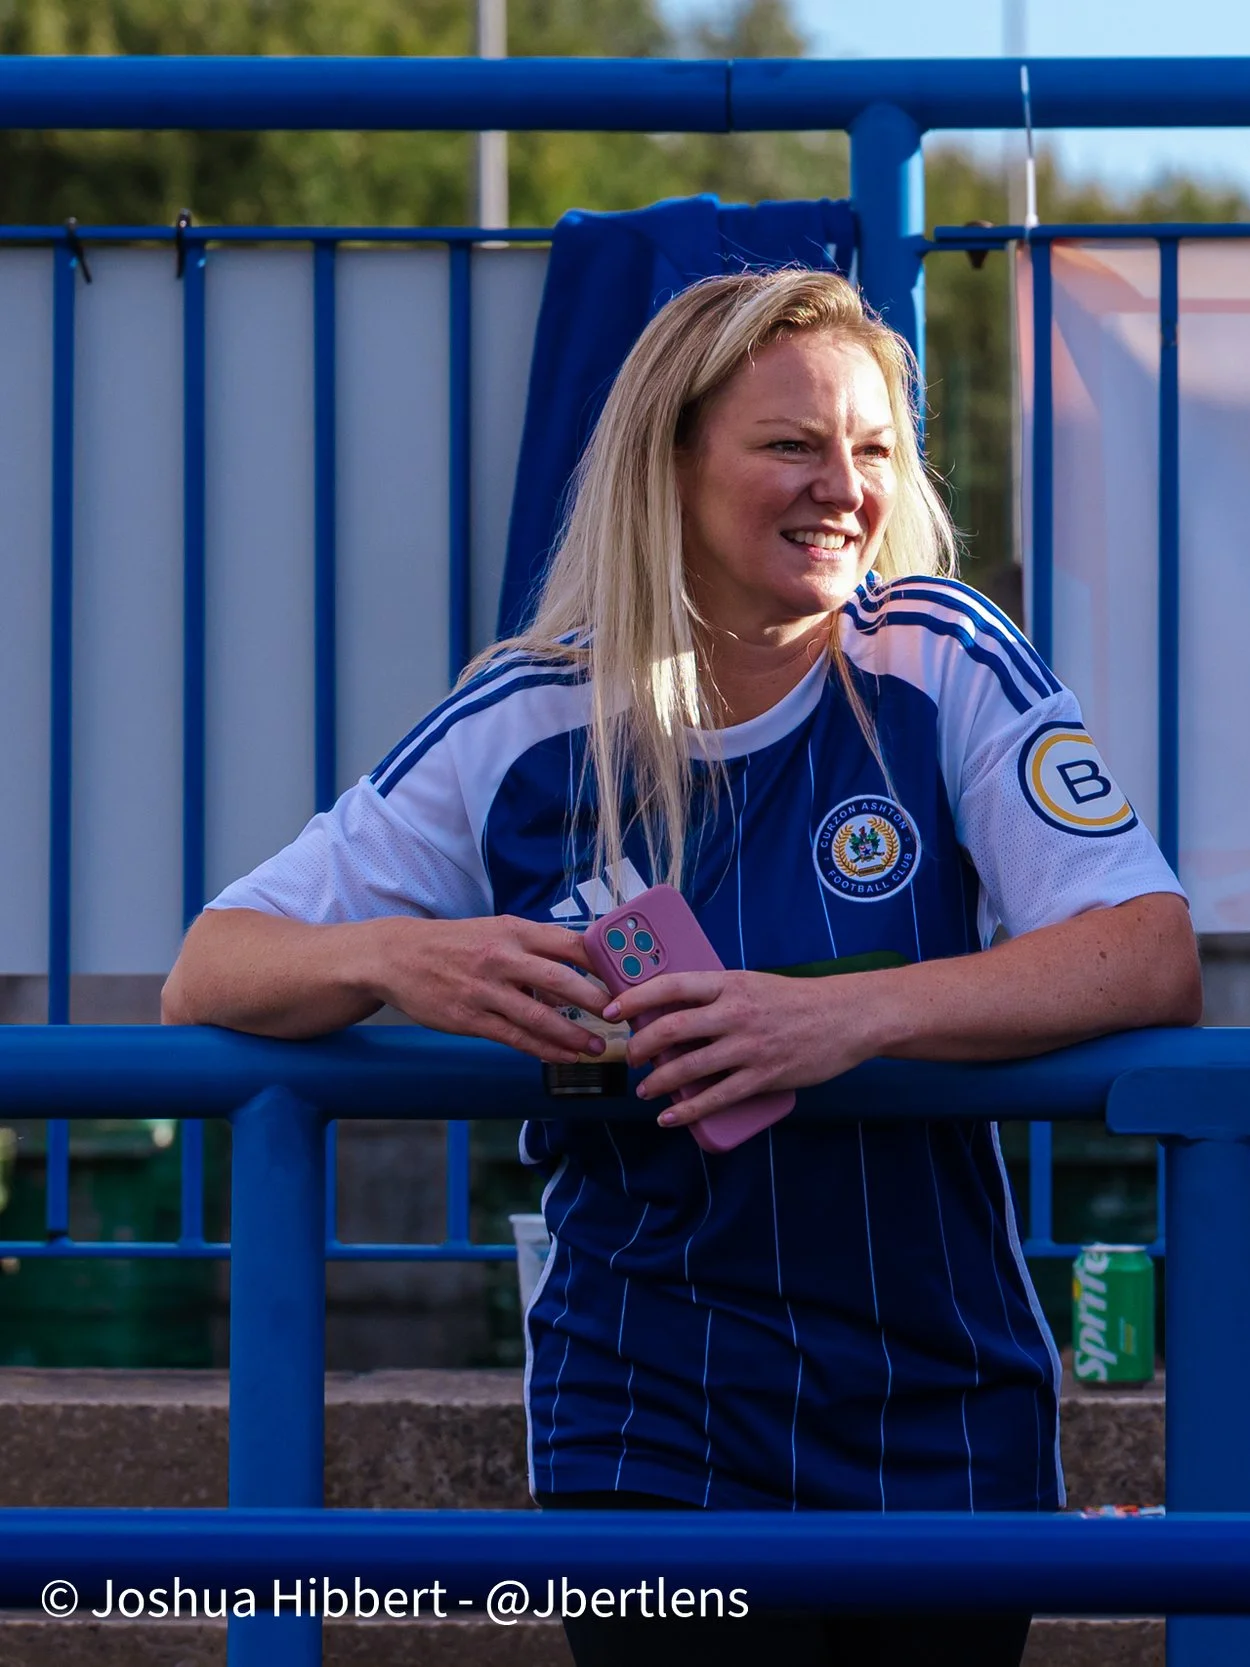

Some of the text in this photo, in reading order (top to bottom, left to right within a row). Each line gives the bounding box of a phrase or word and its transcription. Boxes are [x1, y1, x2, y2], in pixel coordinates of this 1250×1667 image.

[1056, 759, 1111, 804] B
[820, 802, 907, 848] CURZON ASHTON
[828, 870, 890, 893] FOOTBALL
[891, 852, 913, 881] CLUB
[1075, 1249, 1117, 1383] Sprite
